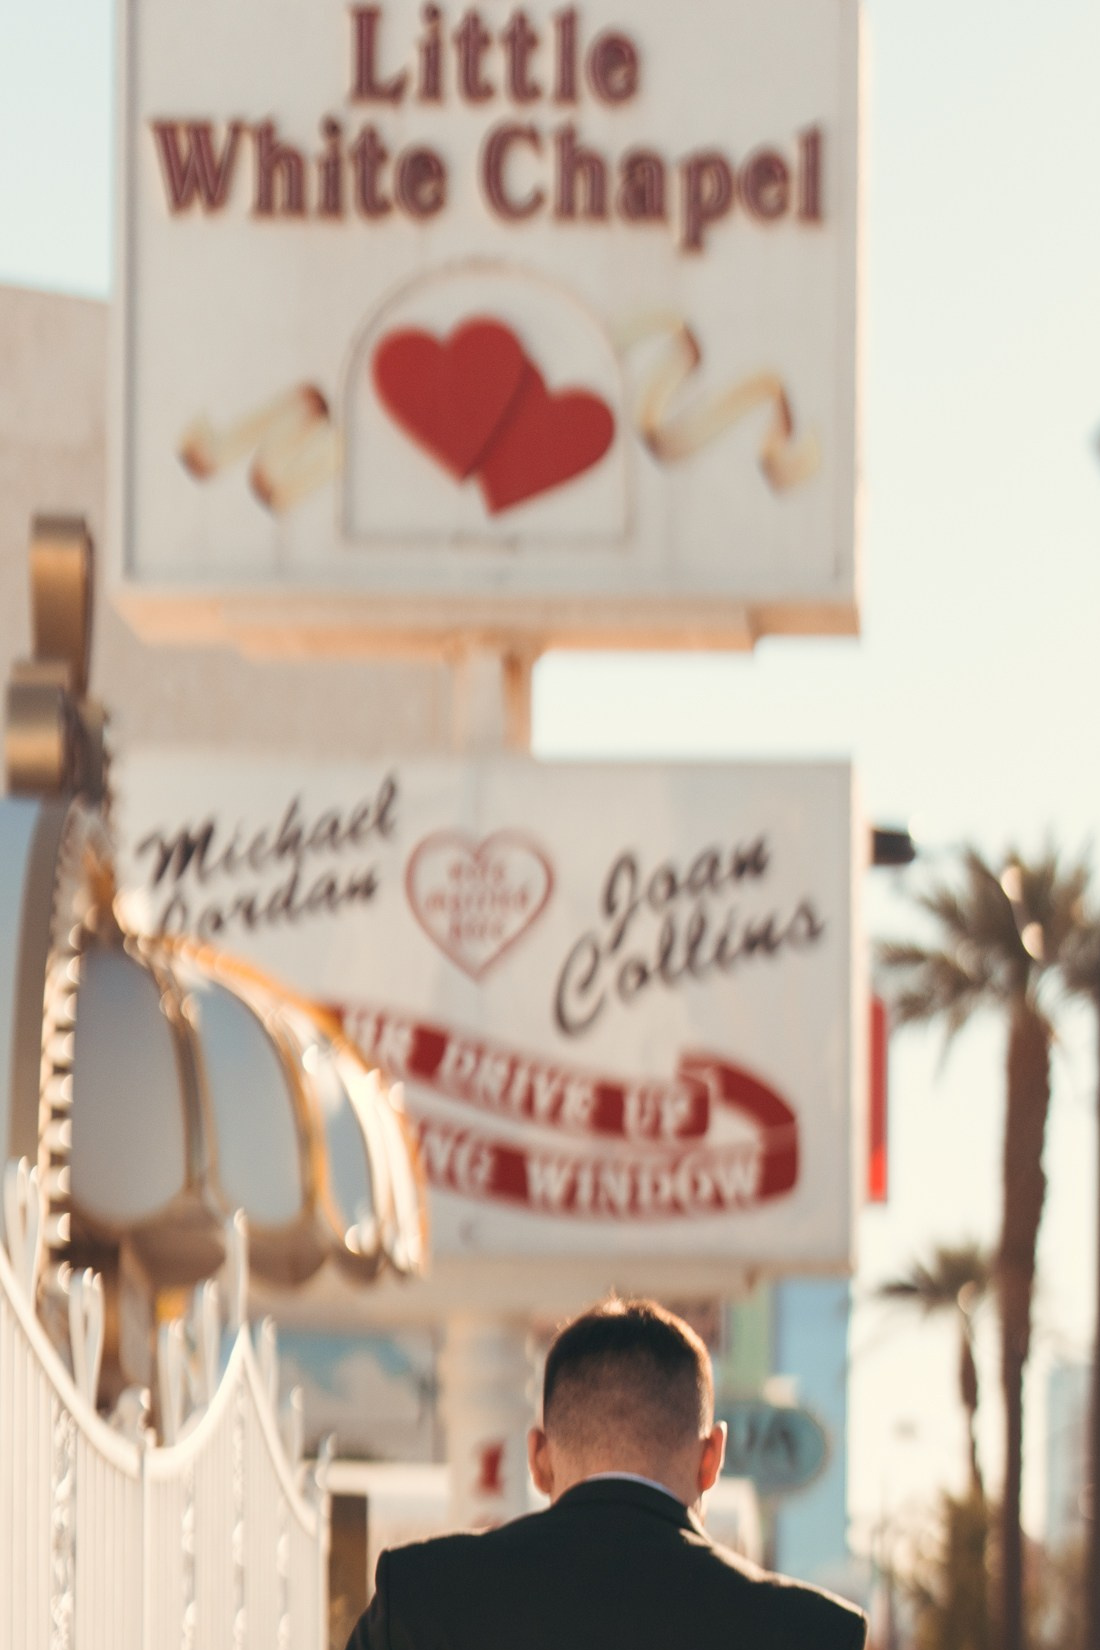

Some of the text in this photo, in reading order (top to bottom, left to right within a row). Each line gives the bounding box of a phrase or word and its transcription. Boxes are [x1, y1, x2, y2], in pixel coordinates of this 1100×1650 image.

[349, 3, 640, 108] Little
[150, 112, 826, 256] White Chapel
[134, 772, 398, 890] Michael
[602, 834, 770, 955] Joan
[553, 892, 826, 1038] Collins
[437, 1034, 597, 1132] DRIVE
[621, 1080, 693, 1142] UP
[526, 1148, 762, 1212] WINDOW
